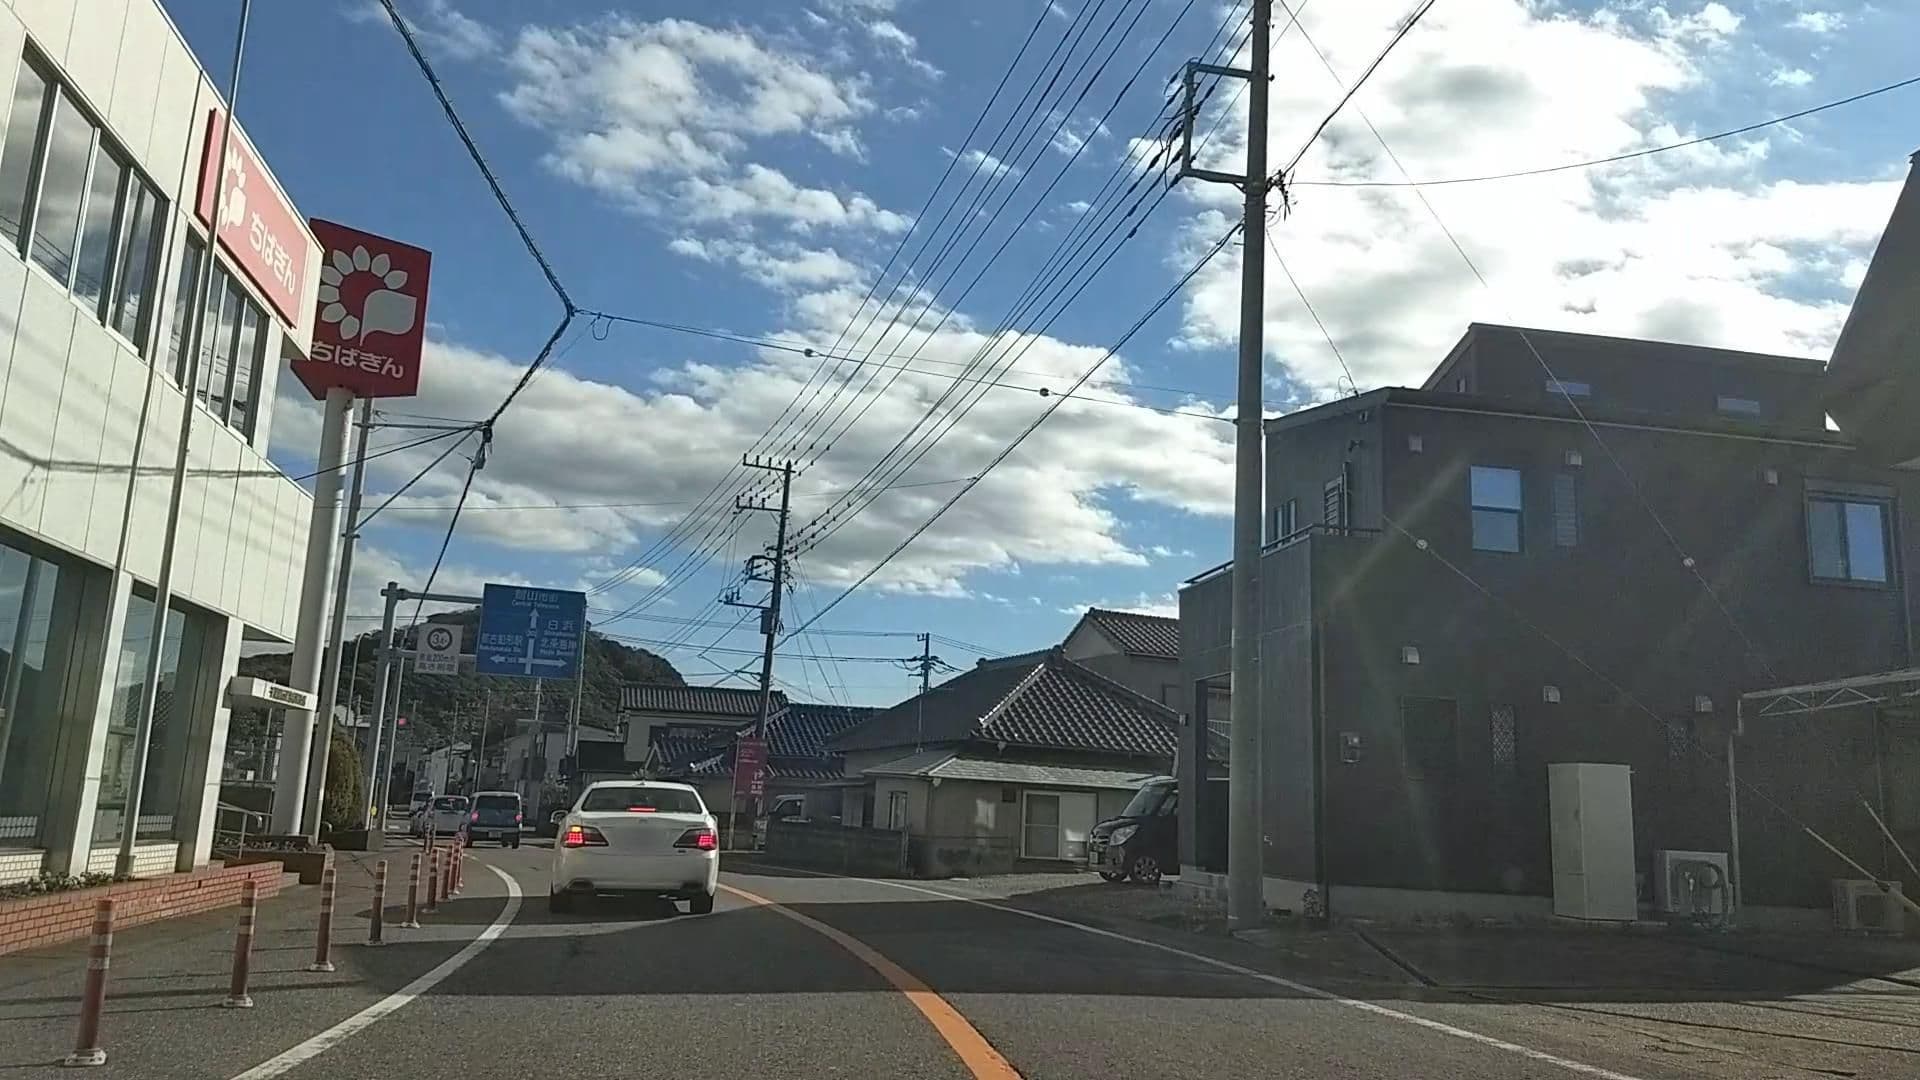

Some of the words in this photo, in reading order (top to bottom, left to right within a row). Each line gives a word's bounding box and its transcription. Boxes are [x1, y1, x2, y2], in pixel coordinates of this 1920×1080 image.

[249, 210, 297, 296] ちばぎん
[311, 339, 404, 379] ちばぎん
